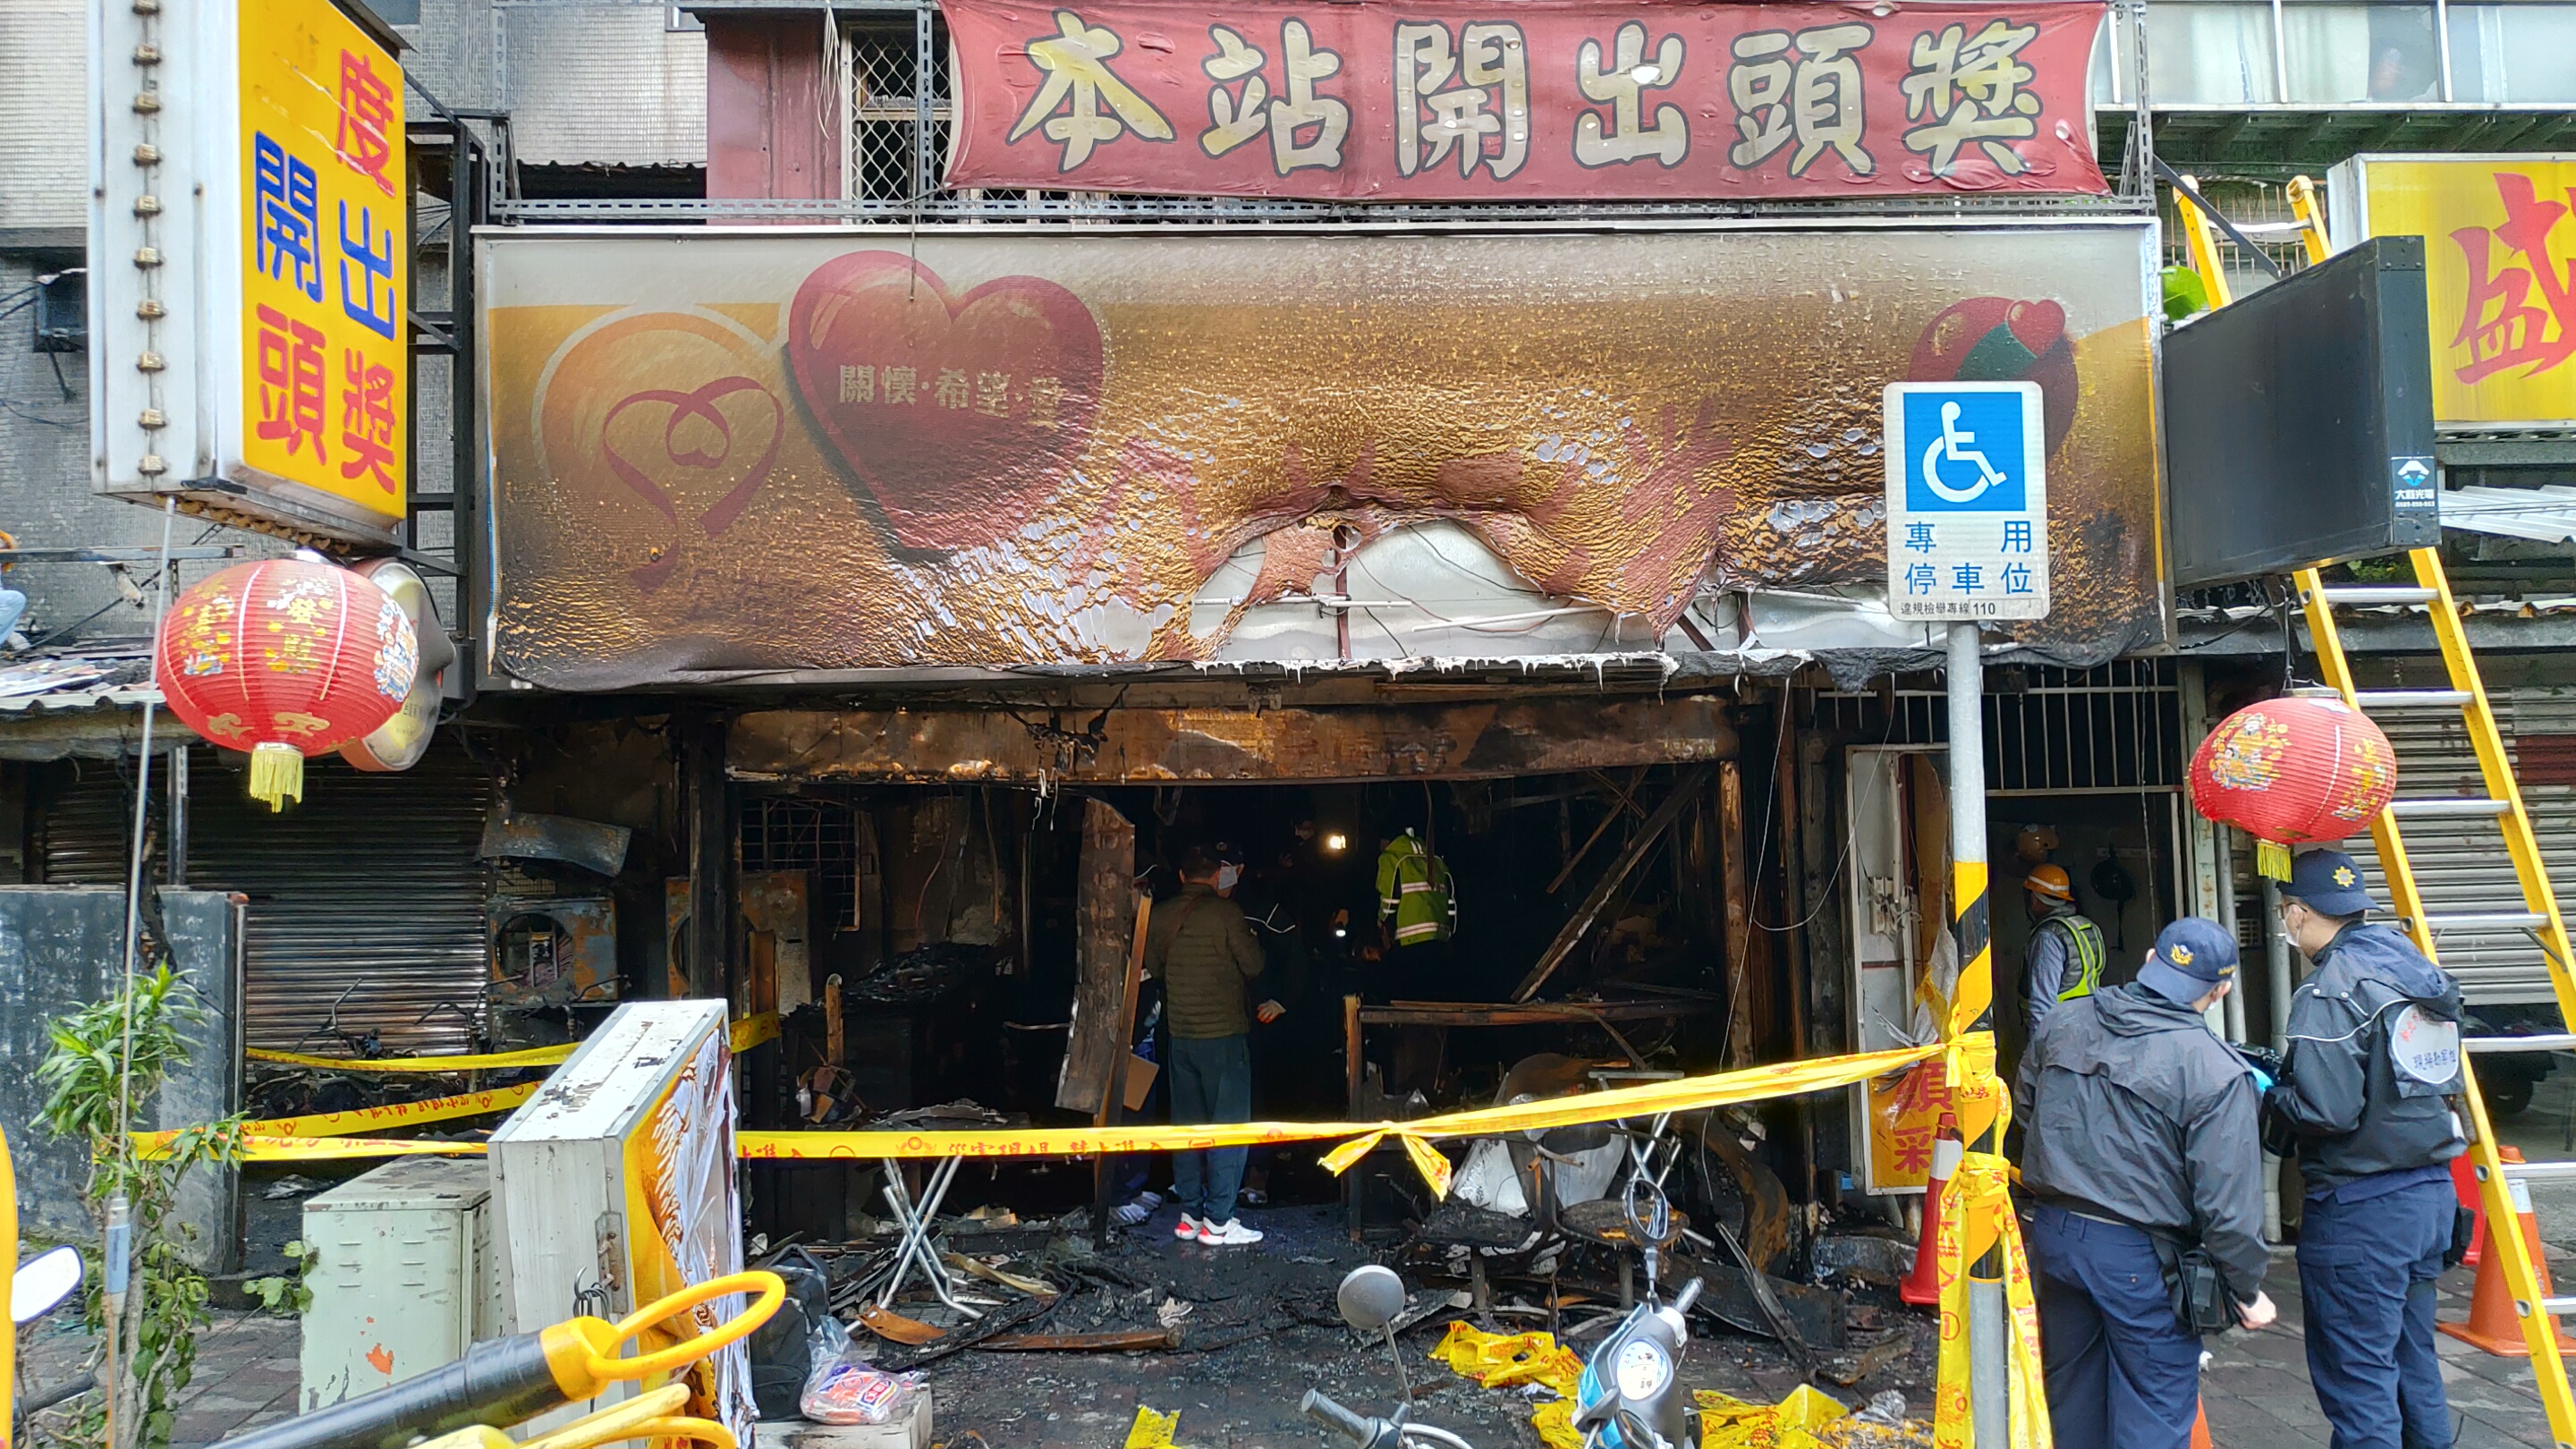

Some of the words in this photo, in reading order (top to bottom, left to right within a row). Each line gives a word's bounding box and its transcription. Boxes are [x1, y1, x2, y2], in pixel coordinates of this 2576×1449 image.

[337, 48, 396, 198] 度
[1009, 11, 2043, 181] 本站開出頭獎
[254, 130, 395, 342] 開出
[1904, 562, 2033, 596] 停車位
